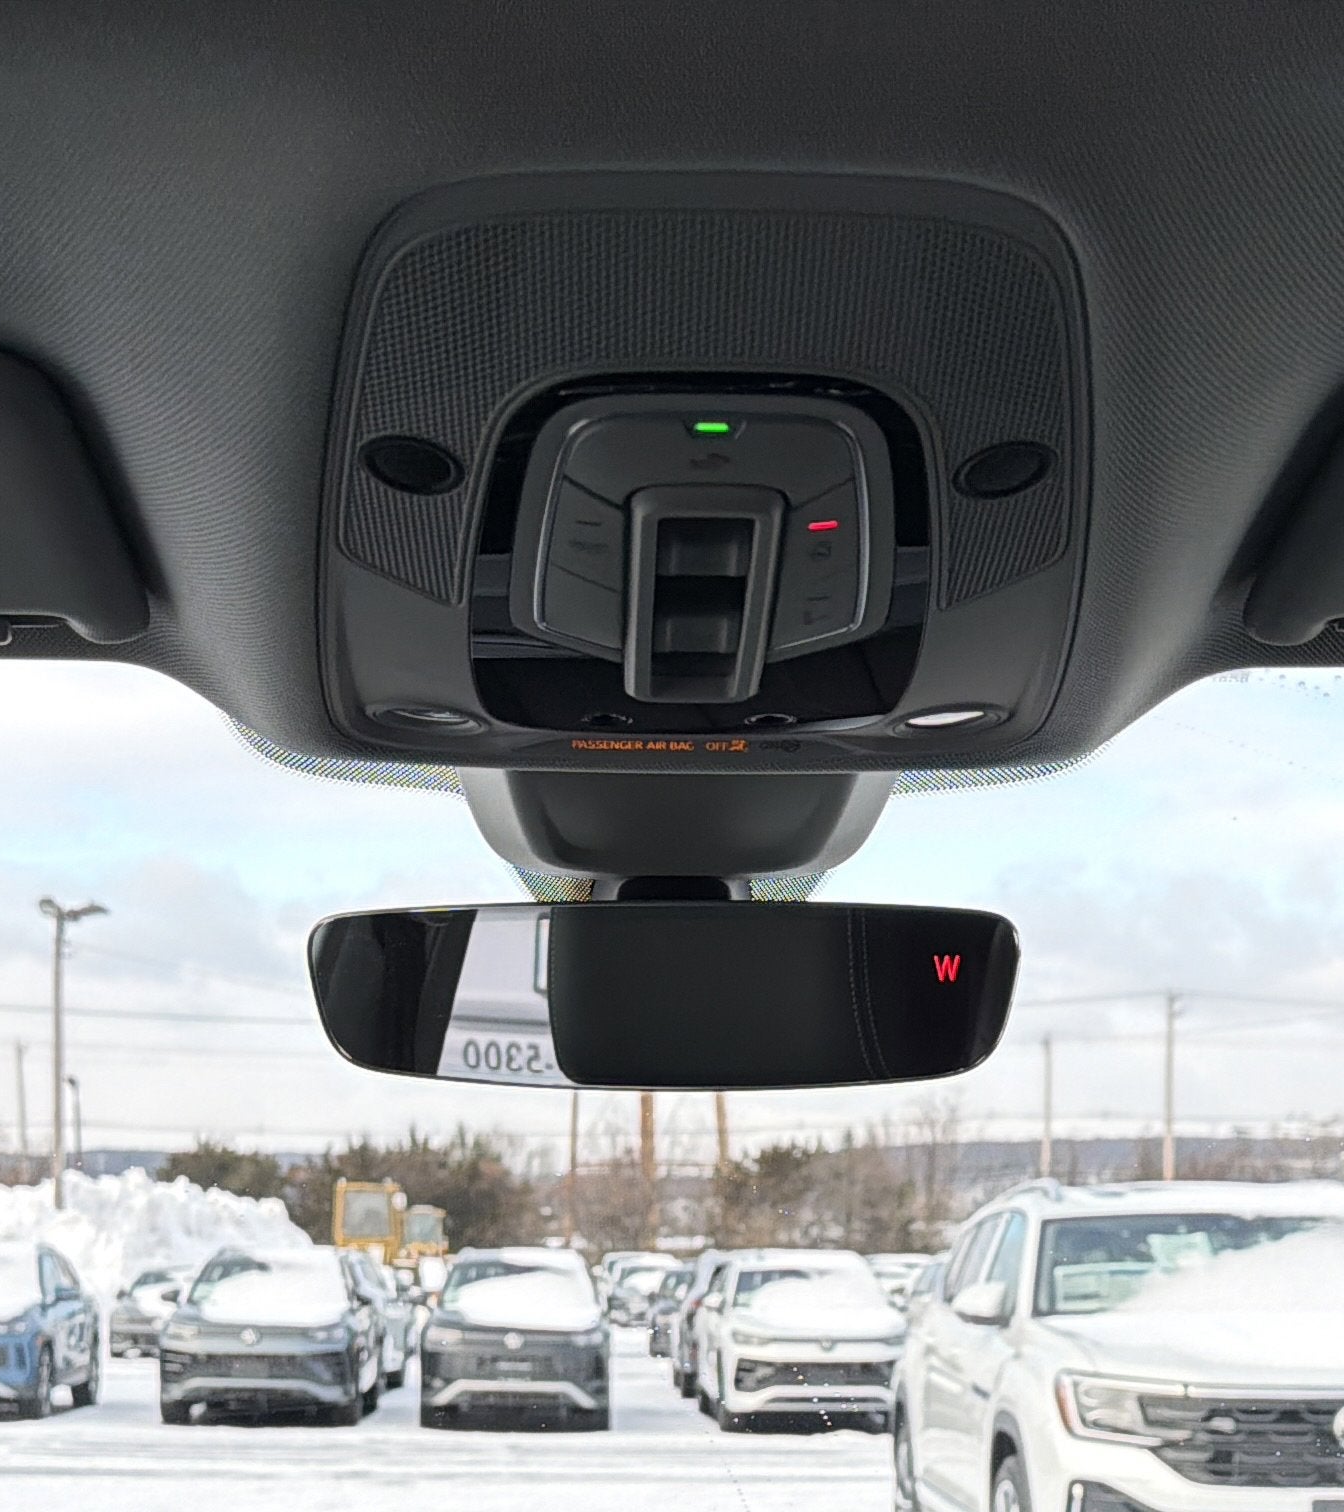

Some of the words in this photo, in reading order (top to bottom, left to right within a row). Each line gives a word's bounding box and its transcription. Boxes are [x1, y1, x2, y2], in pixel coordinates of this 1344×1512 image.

[571, 740, 644, 751] PASSENGER
[647, 740, 667, 751] AIR
[670, 740, 694, 751] BAG
[706, 740, 728, 751] OFF
[933, 954, 961, 982] W
